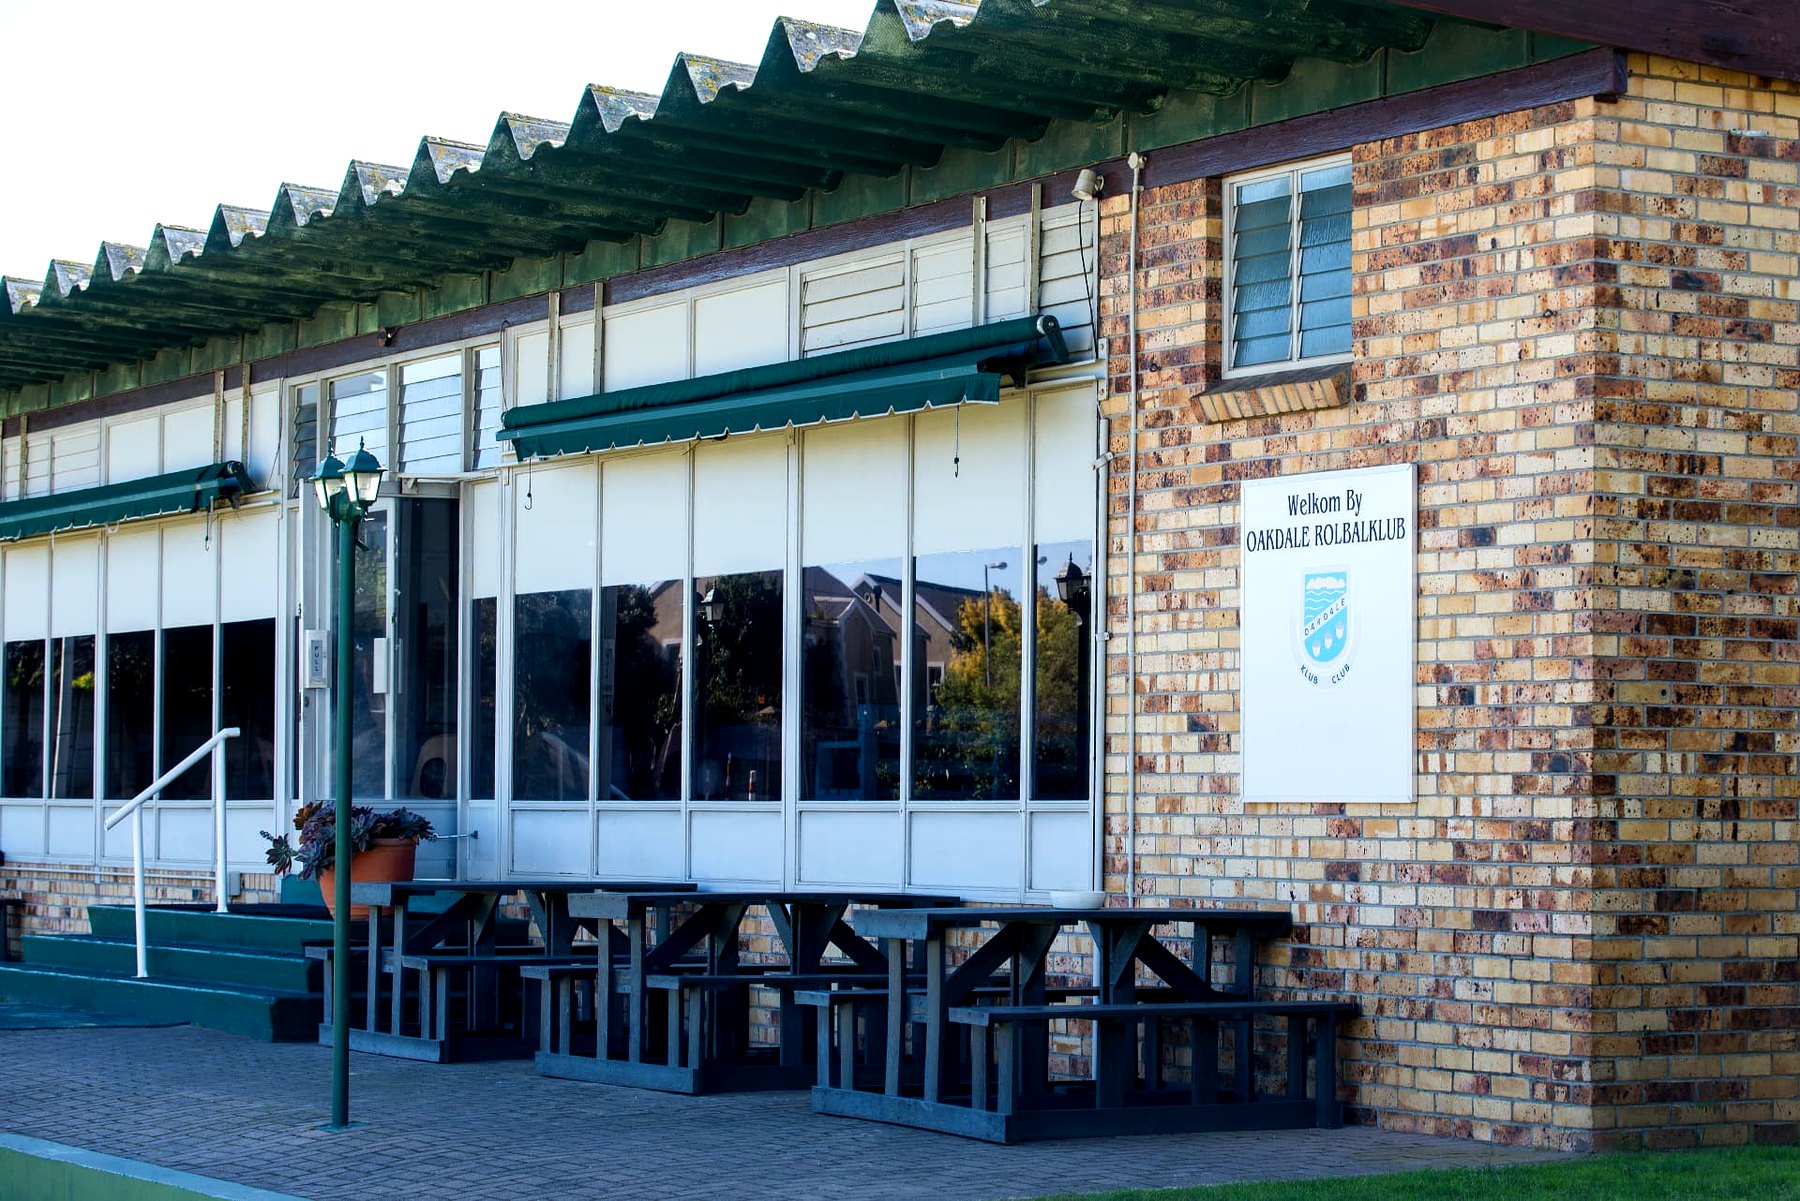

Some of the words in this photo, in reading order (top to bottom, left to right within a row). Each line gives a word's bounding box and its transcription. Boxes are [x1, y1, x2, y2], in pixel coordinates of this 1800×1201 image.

[1288, 492, 1341, 516] Welkom
[1346, 489, 1363, 516] By
[1247, 526, 1310, 552] OAKDALE
[1315, 517, 1406, 546] ROLBALKLUB
[1304, 598, 1345, 636] OAKDALE
[313, 645, 321, 672] PULL
[1300, 664, 1319, 685] KLUB
[1331, 663, 1350, 684] CLUB
